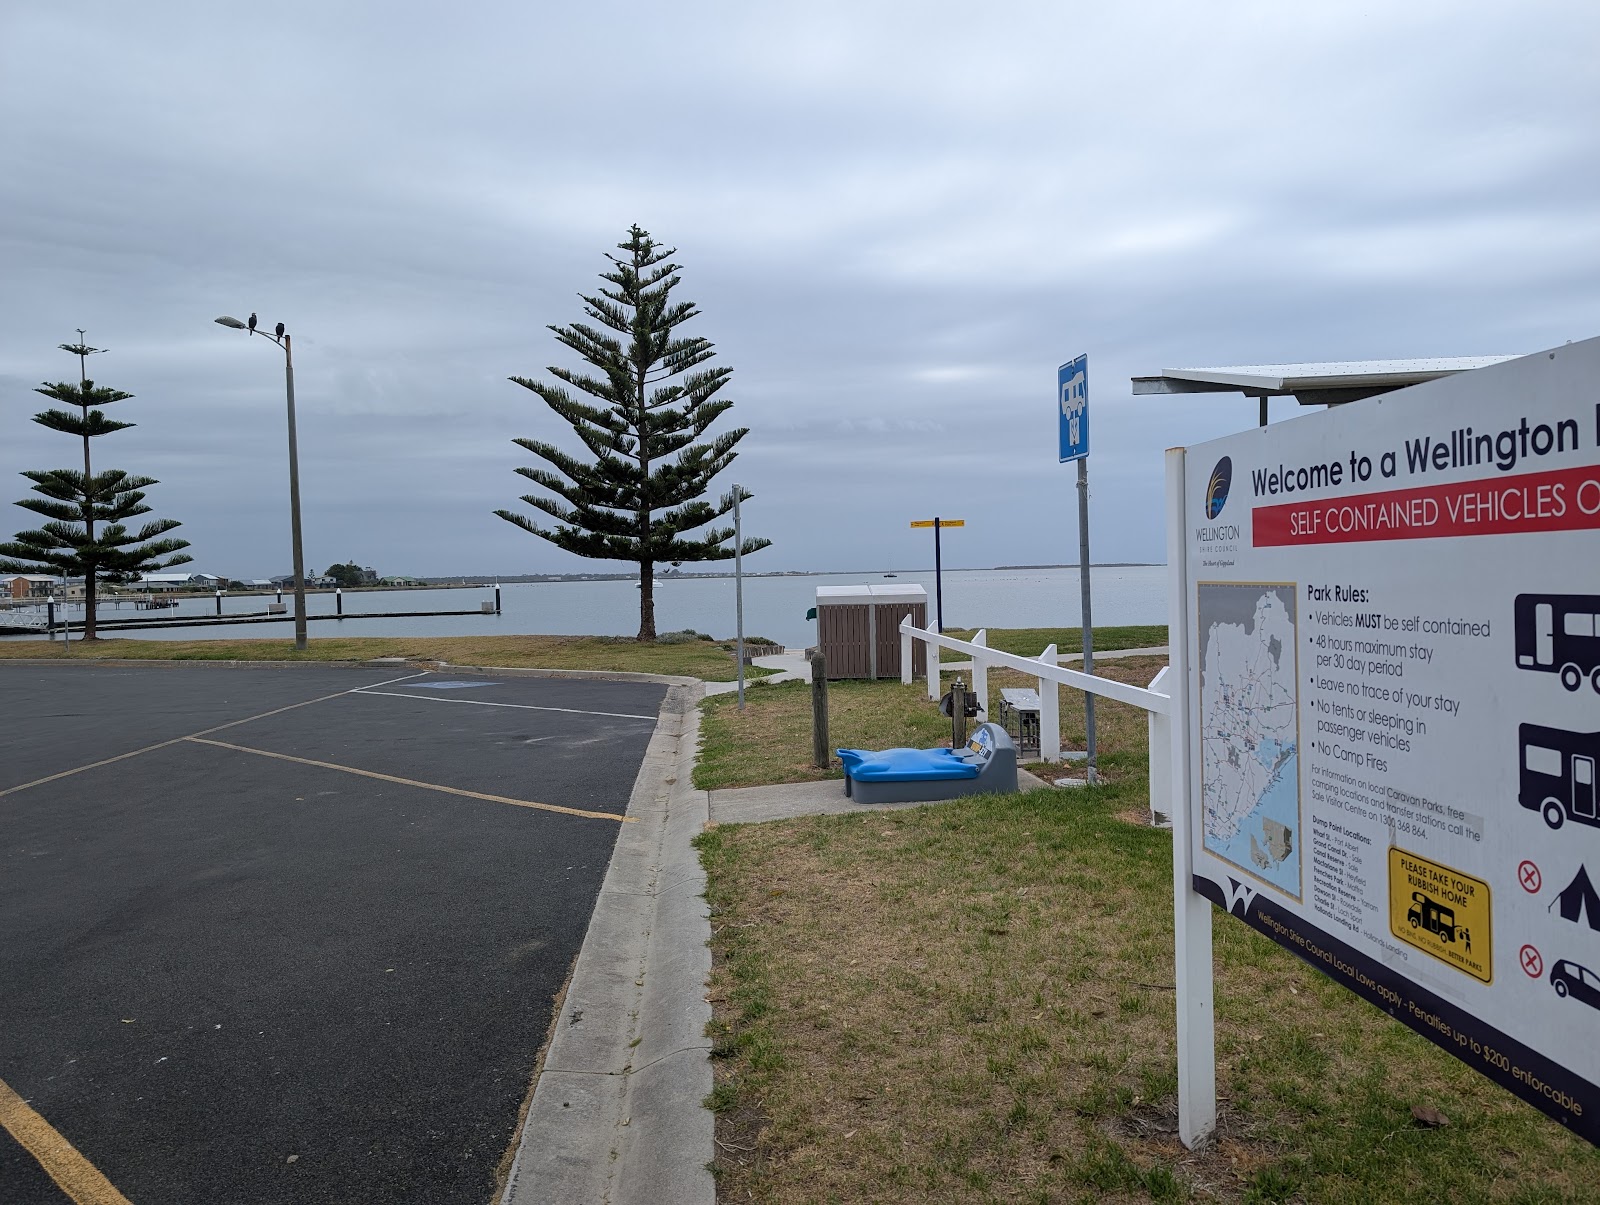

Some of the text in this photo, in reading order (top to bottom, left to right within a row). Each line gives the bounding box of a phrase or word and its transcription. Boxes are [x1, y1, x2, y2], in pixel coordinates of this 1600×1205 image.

[1252, 462, 1343, 496] Welcome
[1350, 451, 1372, 482] to
[1381, 451, 1396, 478] a
[1405, 417, 1579, 474] Wellington
[1290, 510, 1321, 535] SELF
[1325, 498, 1439, 533] CONTAINED
[1445, 483, 1566, 523] VEHICLES
[1196, 525, 1240, 541] WELLINGTON
[1308, 584, 1369, 602] Park Rules:
[1315, 611, 1491, 637] Vehicles MUST be self contained
[1316, 635, 1434, 664] 48 hours maximum stay
[1316, 654, 1403, 677] per 30 day period
[1317, 675, 1460, 717] Leave no trace of your stay
[1317, 699, 1426, 736] No tents or sleeping in
[1318, 719, 1411, 752] passenger vehicles
[1318, 741, 1388, 773] No Camp Fires
[1312, 764, 1464, 820] For information on local Caravan Parks, free
[1312, 778, 1481, 842] camping locations and transfer stations call the
[1312, 790, 1324, 802] Sale
[1326, 794, 1343, 808] Visitor
[1345, 803, 1366, 818] Centre
[1368, 812, 1378, 822] on
[1380, 813, 1396, 828] 1300
[1397, 820, 1410, 834] 368
[1313, 815, 1372, 845] Dump Point Locations:
[1313, 838, 1326, 848] Grand
[1327, 844, 1341, 856] Canal
[1352, 854, 1362, 864] Sale
[1313, 847, 1358, 872] Canal Reserve Sale
[1314, 875, 1378, 912] Recreation Reserve Yarram
[1401, 859, 1474, 897] PLEASE TAKE YOUR
[1408, 874, 1467, 908] RUBBISH HOME
[1314, 903, 1408, 961] Hollands Landing Rd Hollands Landing
[1257, 910, 1290, 938] Wellington
[1289, 929, 1305, 947] Shire
[1305, 939, 1333, 963] Council
[1333, 955, 1354, 976] Local
[1356, 971, 1376, 991] Laws
[1377, 984, 1402, 1008] apply
[1408, 1000, 1452, 1037] Penalties
[1453, 1030, 1468, 1047] up
[1470, 1036, 1481, 1054] to
[1483, 1045, 1510, 1072] $200
[1511, 1066, 1582, 1116] enforcable
